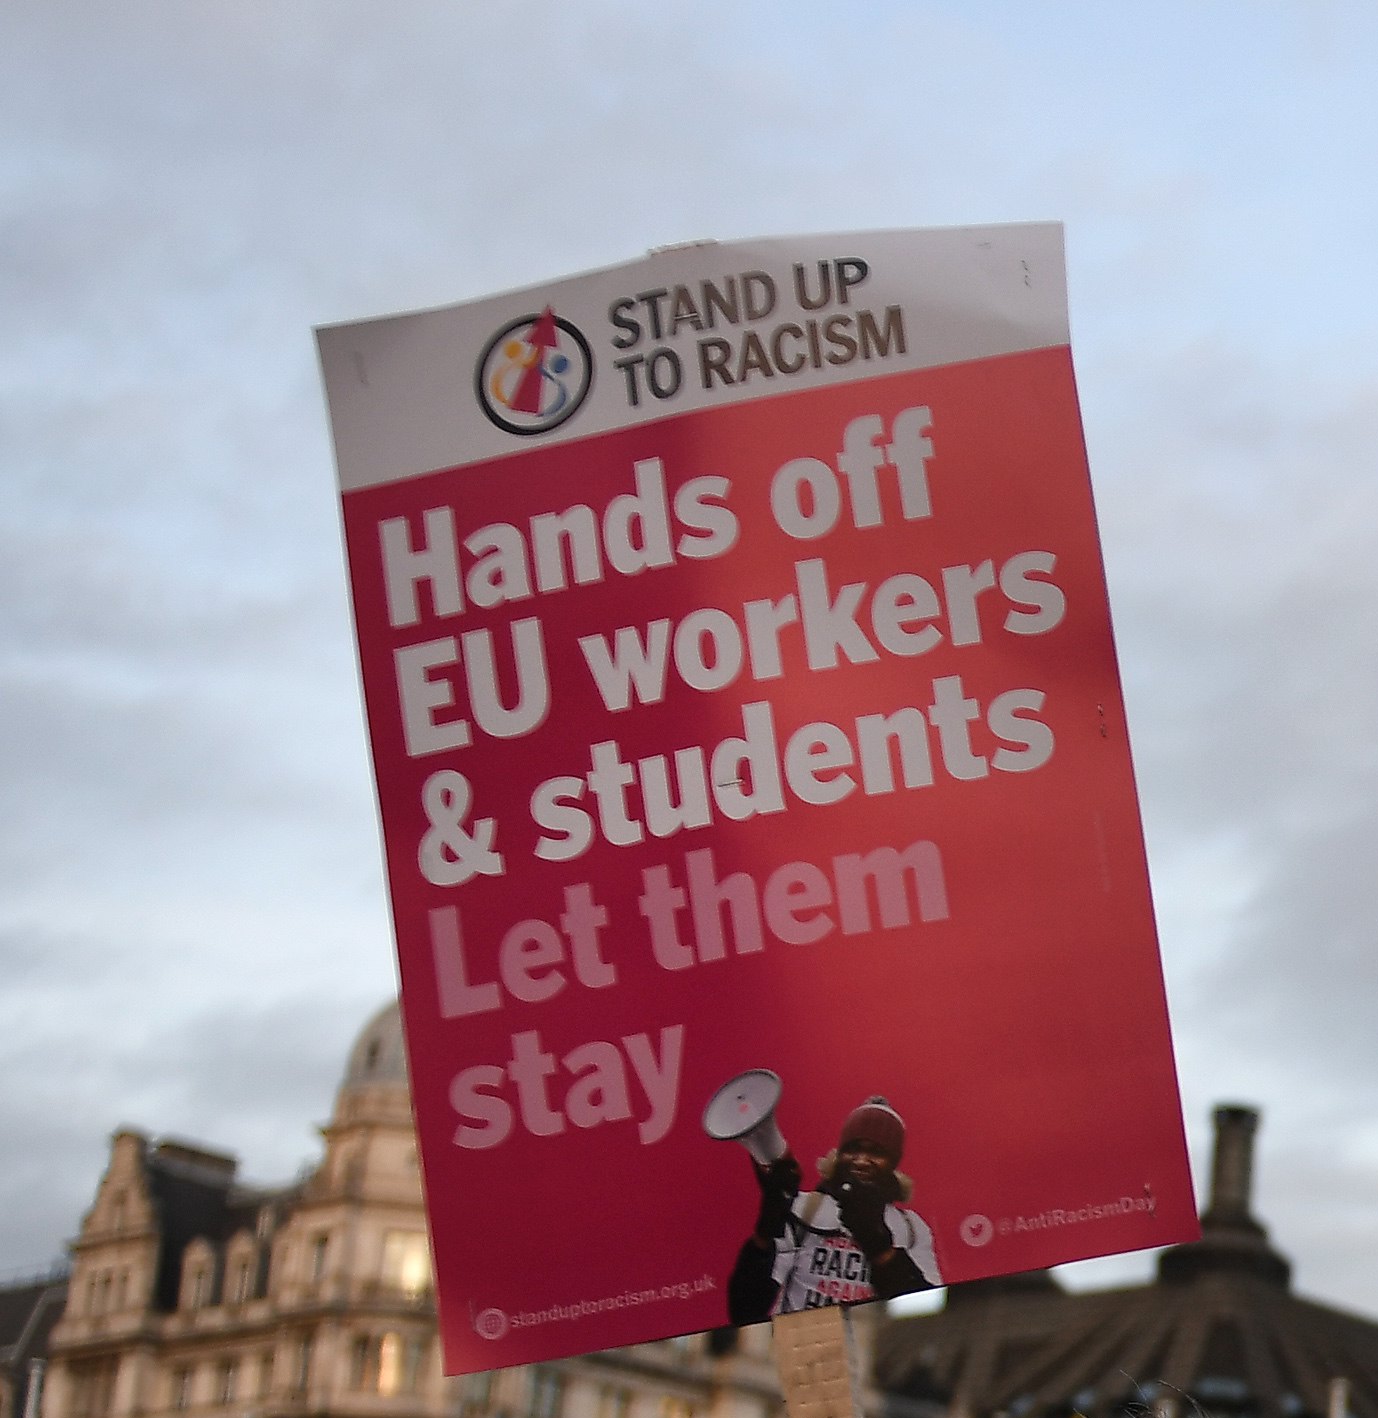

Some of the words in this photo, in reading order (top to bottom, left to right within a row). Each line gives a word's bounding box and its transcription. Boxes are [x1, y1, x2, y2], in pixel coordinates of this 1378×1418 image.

[608, 269, 777, 350] STAND
[793, 256, 870, 311] UP
[613, 346, 682, 407] TO
[696, 304, 907, 389] RACISM
[377, 457, 738, 629] Hands
[770, 405, 936, 540] off
[393, 615, 552, 758] EU
[577, 549, 1068, 713] workers
[418, 769, 505, 887] &
[530, 674, 1056, 862] students
[427, 882, 617, 1020] Let
[639, 838, 951, 972] them
[448, 1025, 686, 1151] stay
